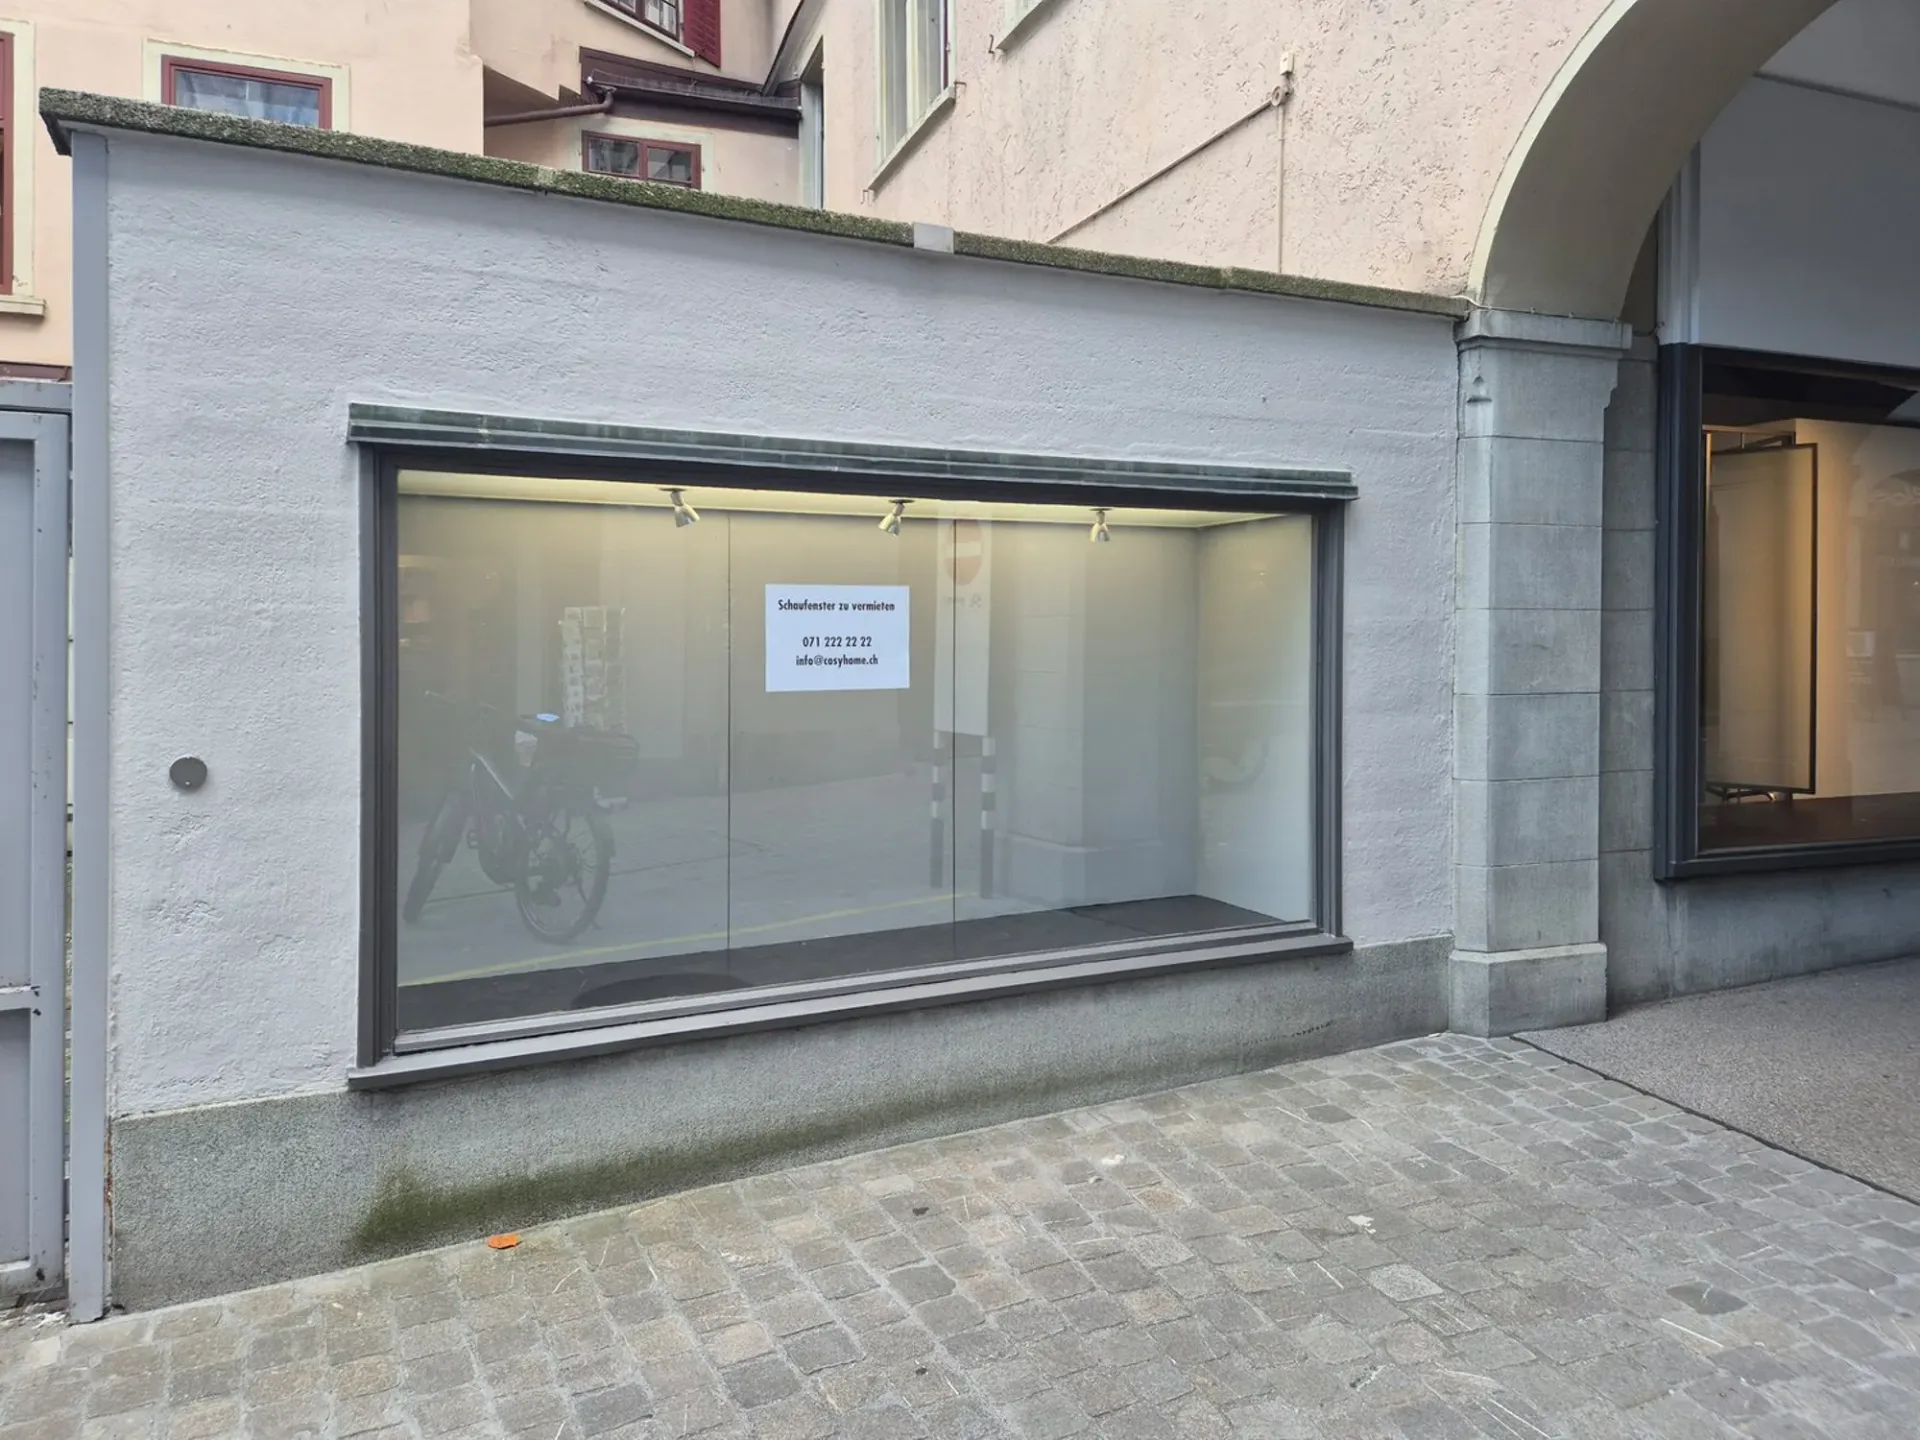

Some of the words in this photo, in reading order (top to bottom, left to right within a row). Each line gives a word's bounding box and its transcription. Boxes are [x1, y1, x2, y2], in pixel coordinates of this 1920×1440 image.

[777, 598, 836, 611] Schaufenster
[838, 602, 849, 611] zu
[851, 600, 896, 611] vermieten
[802, 636, 820, 647] 071
[823, 636, 842, 647] 222
[845, 636, 857, 647] 22
[860, 636, 873, 647] 22
[795, 653, 879, 668] info@cosyhome.ch
